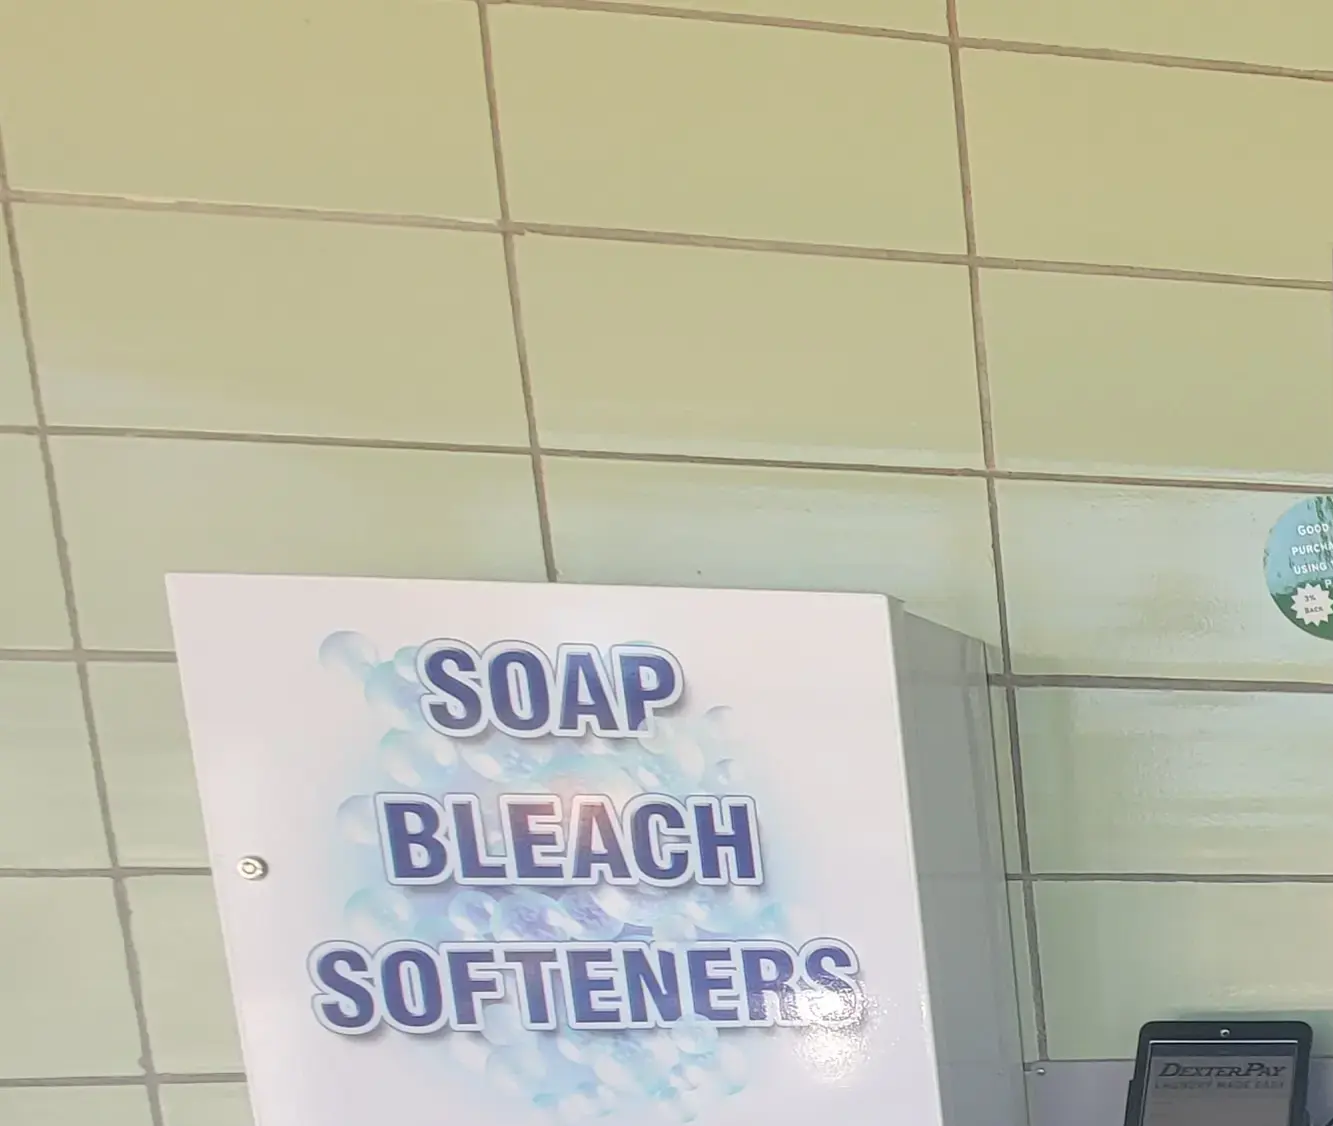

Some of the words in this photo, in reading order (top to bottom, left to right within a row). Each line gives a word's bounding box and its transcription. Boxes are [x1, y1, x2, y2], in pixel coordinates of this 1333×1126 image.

[1294, 562, 1327, 574] USING
[1297, 524, 1329, 536] GOOD
[419, 640, 683, 737] SOAP
[376, 794, 762, 885] BLEACH
[311, 940, 860, 1033] SOFTENERS
